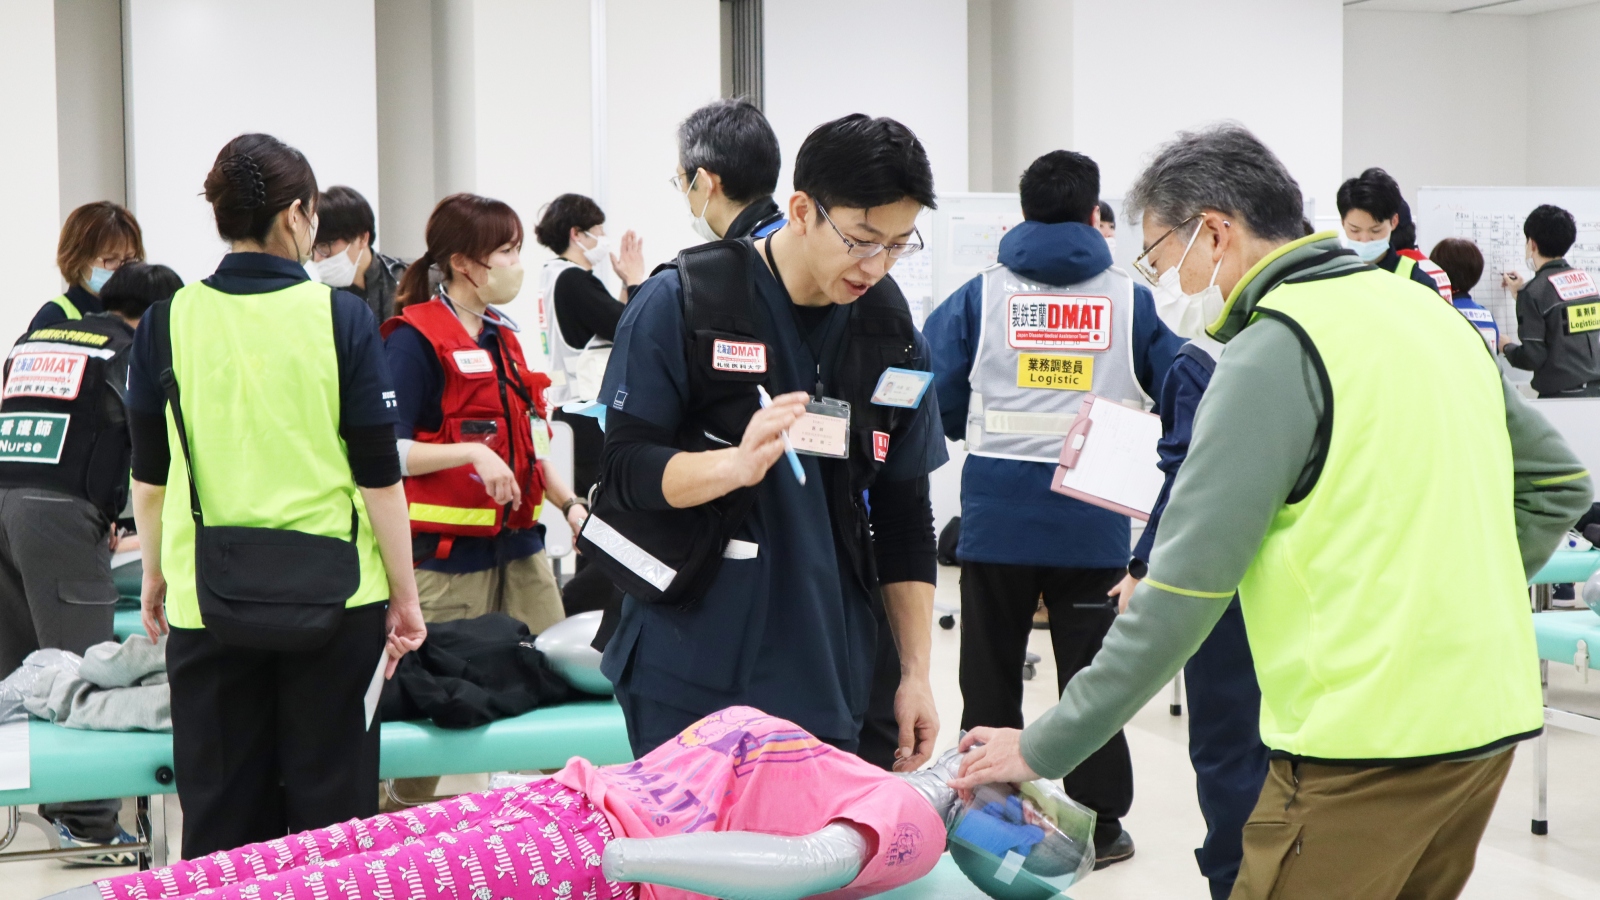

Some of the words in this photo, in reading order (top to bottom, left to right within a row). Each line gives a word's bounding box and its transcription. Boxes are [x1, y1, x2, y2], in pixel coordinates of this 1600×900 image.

[1027, 358, 1083, 374] 業務調整員
[1030, 374, 1079, 385] Logistic
[0, 419, 53, 437] 看護師
[0, 439, 43, 453] Nurse
